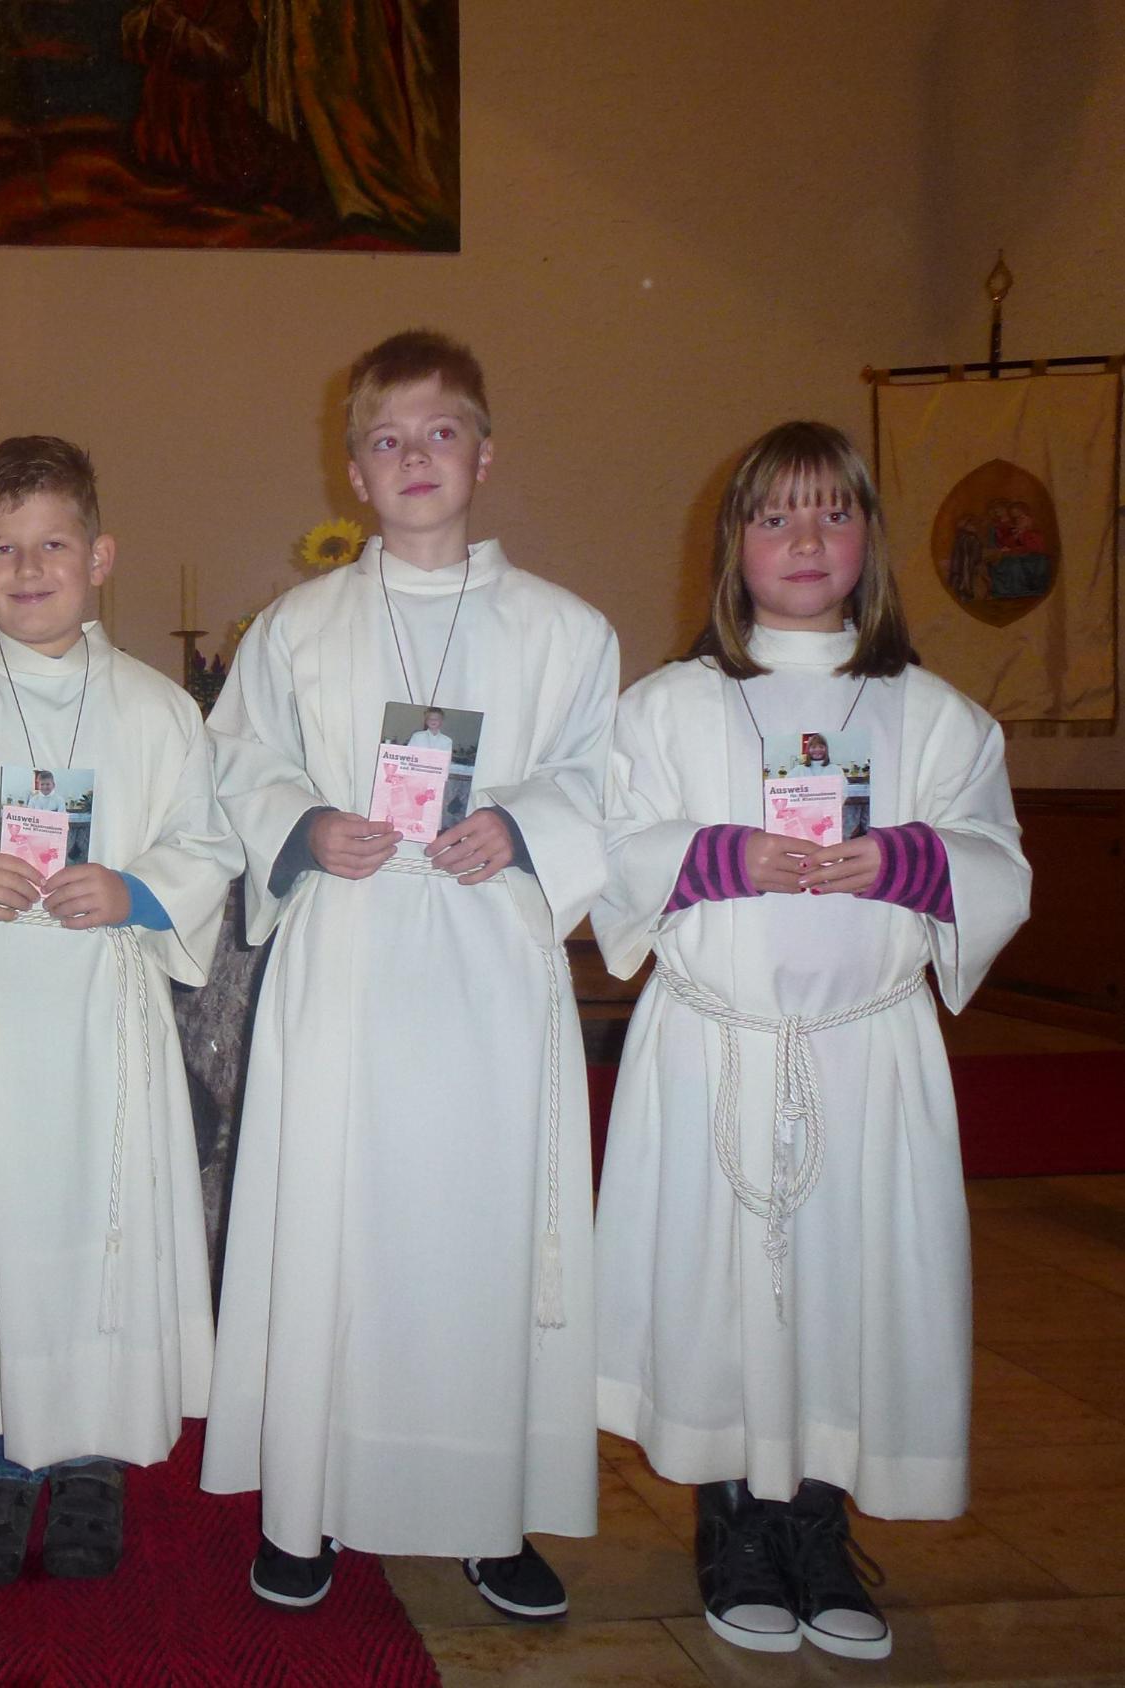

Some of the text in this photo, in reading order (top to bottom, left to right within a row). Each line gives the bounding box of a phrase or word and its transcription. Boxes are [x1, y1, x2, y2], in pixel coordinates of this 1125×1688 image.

[382, 751, 419, 763] Ausweis
[769, 785, 809, 795] Ausweis
[6, 812, 40, 824] Ausweis
